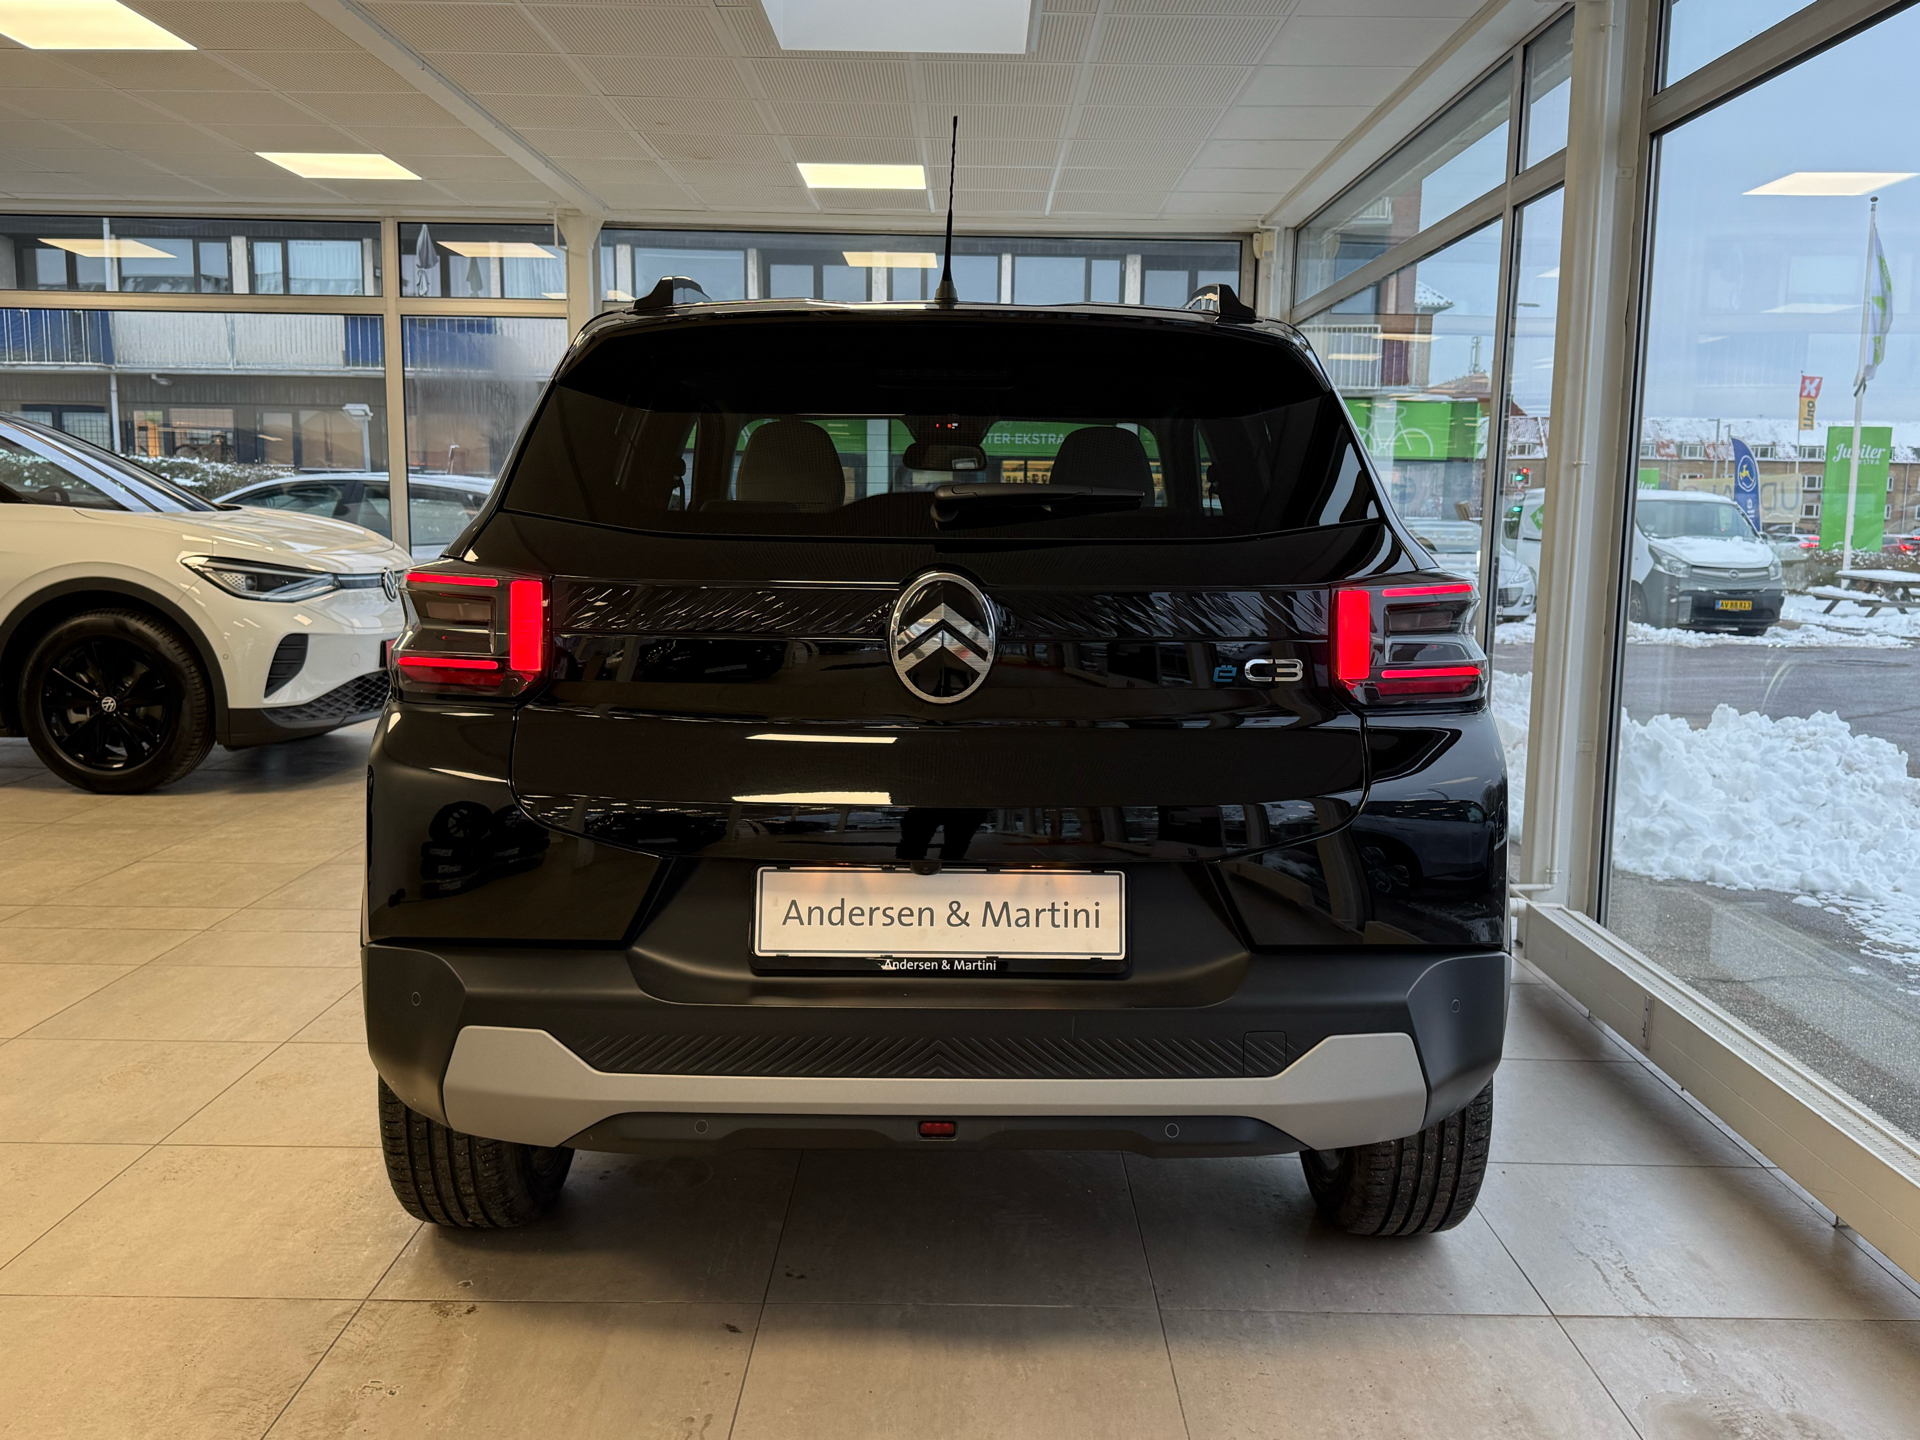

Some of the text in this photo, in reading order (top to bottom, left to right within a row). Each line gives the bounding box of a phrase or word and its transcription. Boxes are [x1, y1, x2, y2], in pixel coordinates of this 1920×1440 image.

[1832, 443, 1886, 463] Juiter
[1244, 659, 1304, 682] C3
[782, 898, 1101, 929] Andersen & Martini
[884, 959, 997, 971] Andersen & Martini
